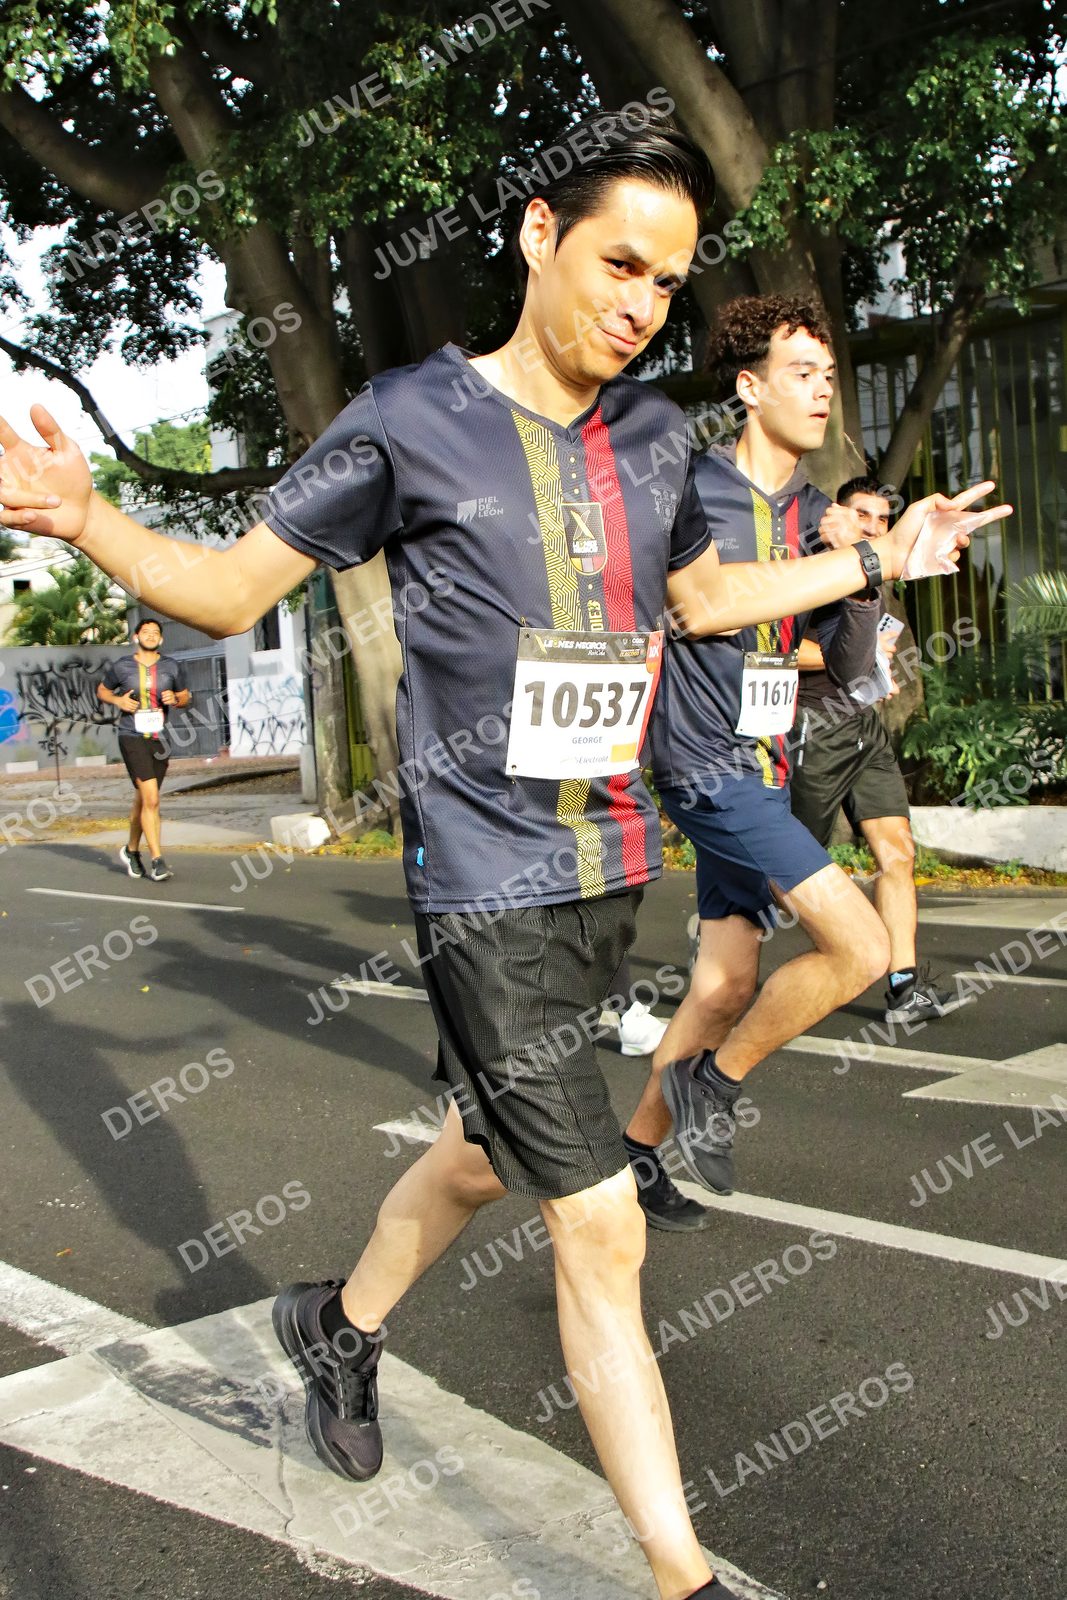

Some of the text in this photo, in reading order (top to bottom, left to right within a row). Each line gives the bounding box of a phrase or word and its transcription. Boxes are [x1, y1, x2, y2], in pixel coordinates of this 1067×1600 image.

[478, 496, 499, 505] PIEL
[479, 503, 491, 511] DE
[479, 507, 504, 518] LEÓN
[524, 681, 647, 728] 10537
[572, 736, 603, 745] GEORGE
